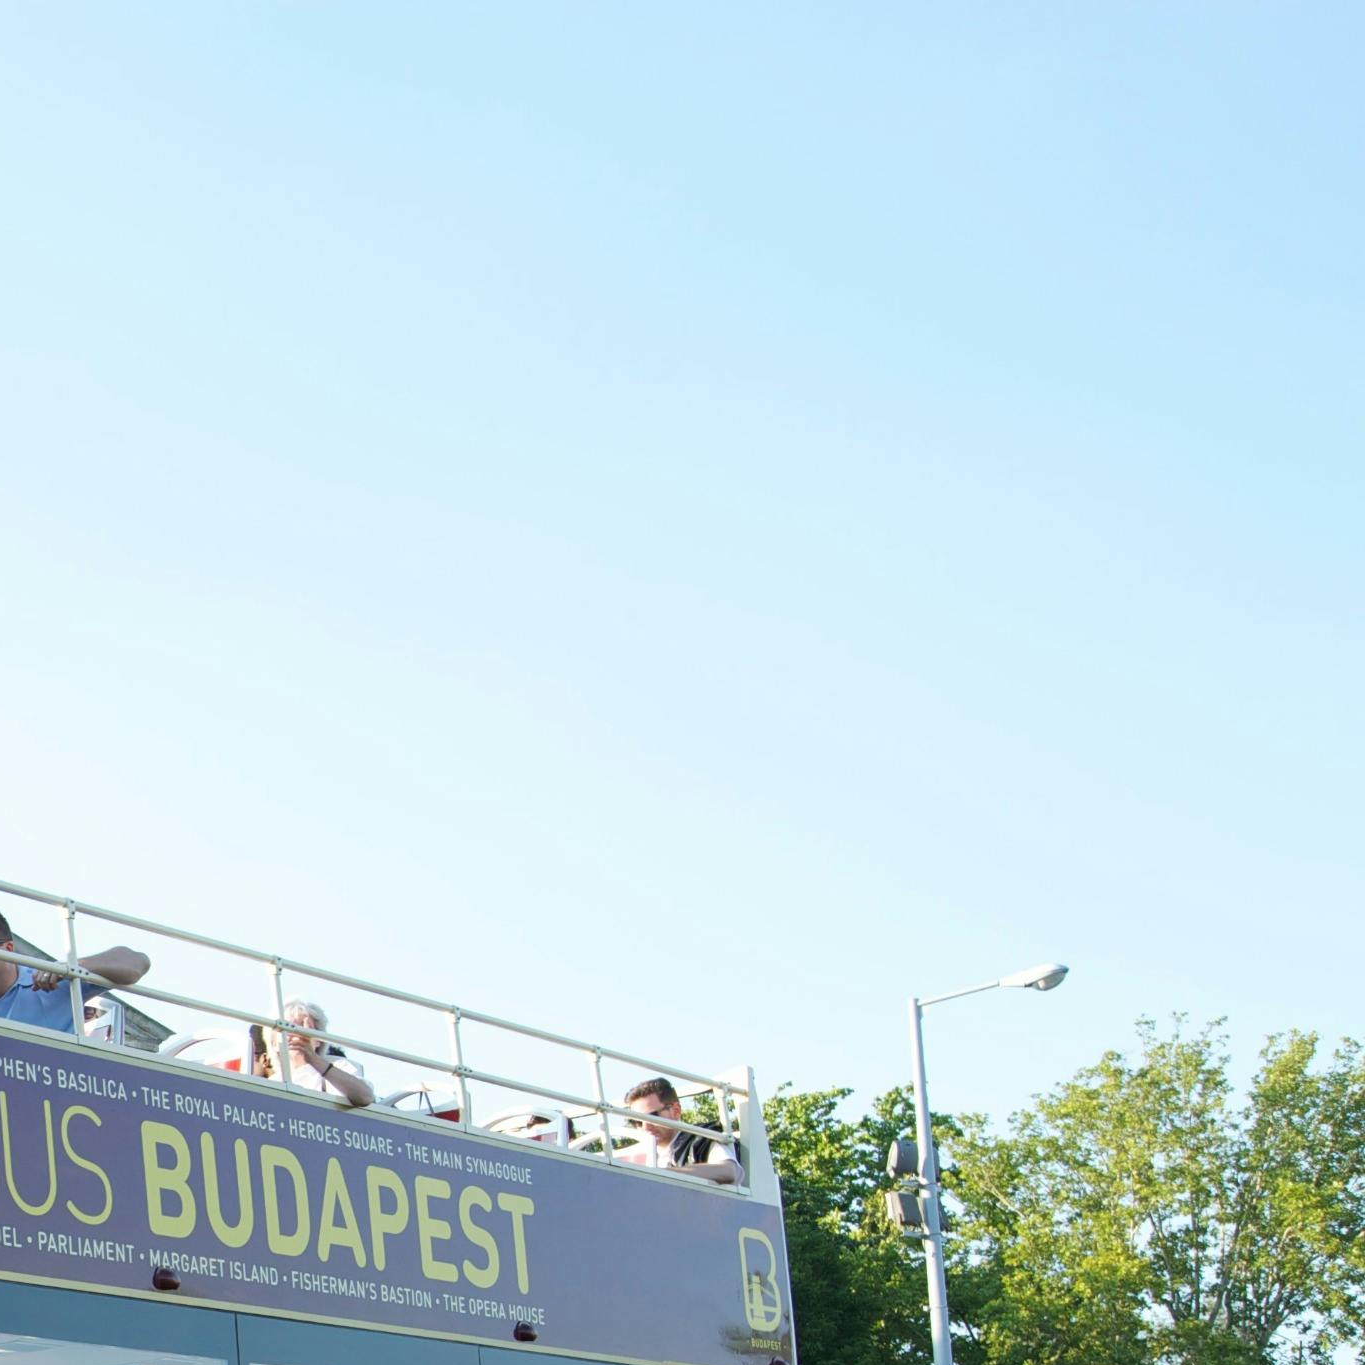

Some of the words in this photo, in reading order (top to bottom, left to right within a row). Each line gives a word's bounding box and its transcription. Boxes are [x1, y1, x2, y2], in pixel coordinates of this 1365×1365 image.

[57, 1068, 128, 1101] BASILICA
[140, 1086, 171, 1110] THE
[174, 1093, 220, 1121] ROYAL
[223, 1104, 276, 1132] PALACE
[288, 1118, 341, 1145] HEROES
[344, 1129, 394, 1157] SQUARE
[404, 1142, 430, 1164] THE
[432, 1148, 463, 1171] MAIN
[465, 1155, 533, 1185] SYNAGOGUE
[140, 1120, 535, 1295] BUDAPEST
[37, 1231, 135, 1264] PARLIAMENT
[149, 1248, 226, 1278] MARGARET
[229, 1261, 279, 1286] ISLAND
[291, 1270, 378, 1301] FISHERMAN'S
[380, 1284, 432, 1309] BASTION
[442, 1293, 466, 1314] THE
[468, 1298, 507, 1319] OPERA
[508, 1304, 546, 1326] HOUSE
[750, 1337, 782, 1351] BUDAPEST
